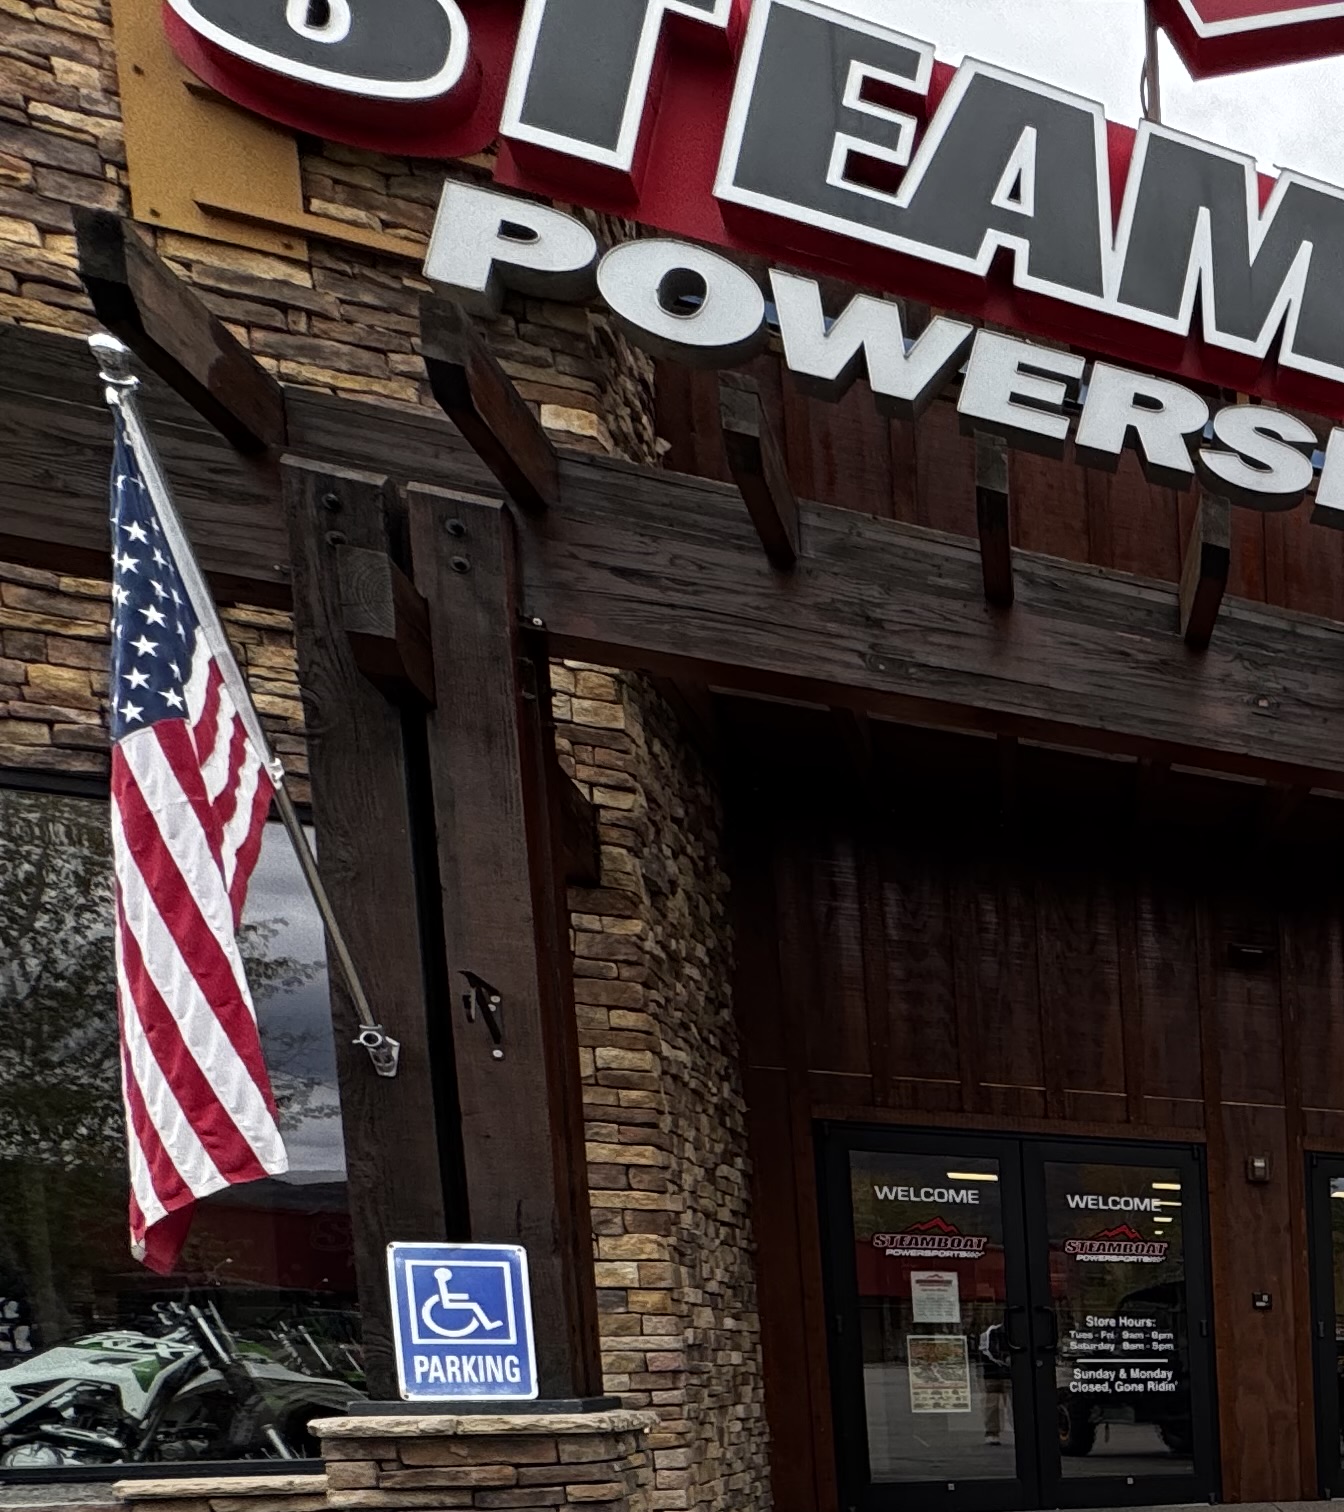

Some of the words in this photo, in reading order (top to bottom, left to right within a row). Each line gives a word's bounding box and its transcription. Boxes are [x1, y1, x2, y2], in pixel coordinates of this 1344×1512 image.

[873, 1185, 980, 1204] WELCOME
[1066, 1194, 1162, 1212] WELCOME
[872, 1233, 988, 1250] STEAMBOAT
[1064, 1240, 1168, 1255] STEAMBOAT
[1085, 1315, 1116, 1327] Store
[1119, 1315, 1157, 1327] Hours:
[1069, 1330, 1093, 1339] Tues
[1069, 1341, 1116, 1352] Saturday
[413, 1355, 522, 1383] PARKING
[1073, 1367, 1116, 1381] Sunday
[1119, 1368, 1127, 1379] &
[1130, 1367, 1174, 1381] Monday
[1069, 1381, 1112, 1393] Closed,
[1115, 1381, 1145, 1392] Gone
